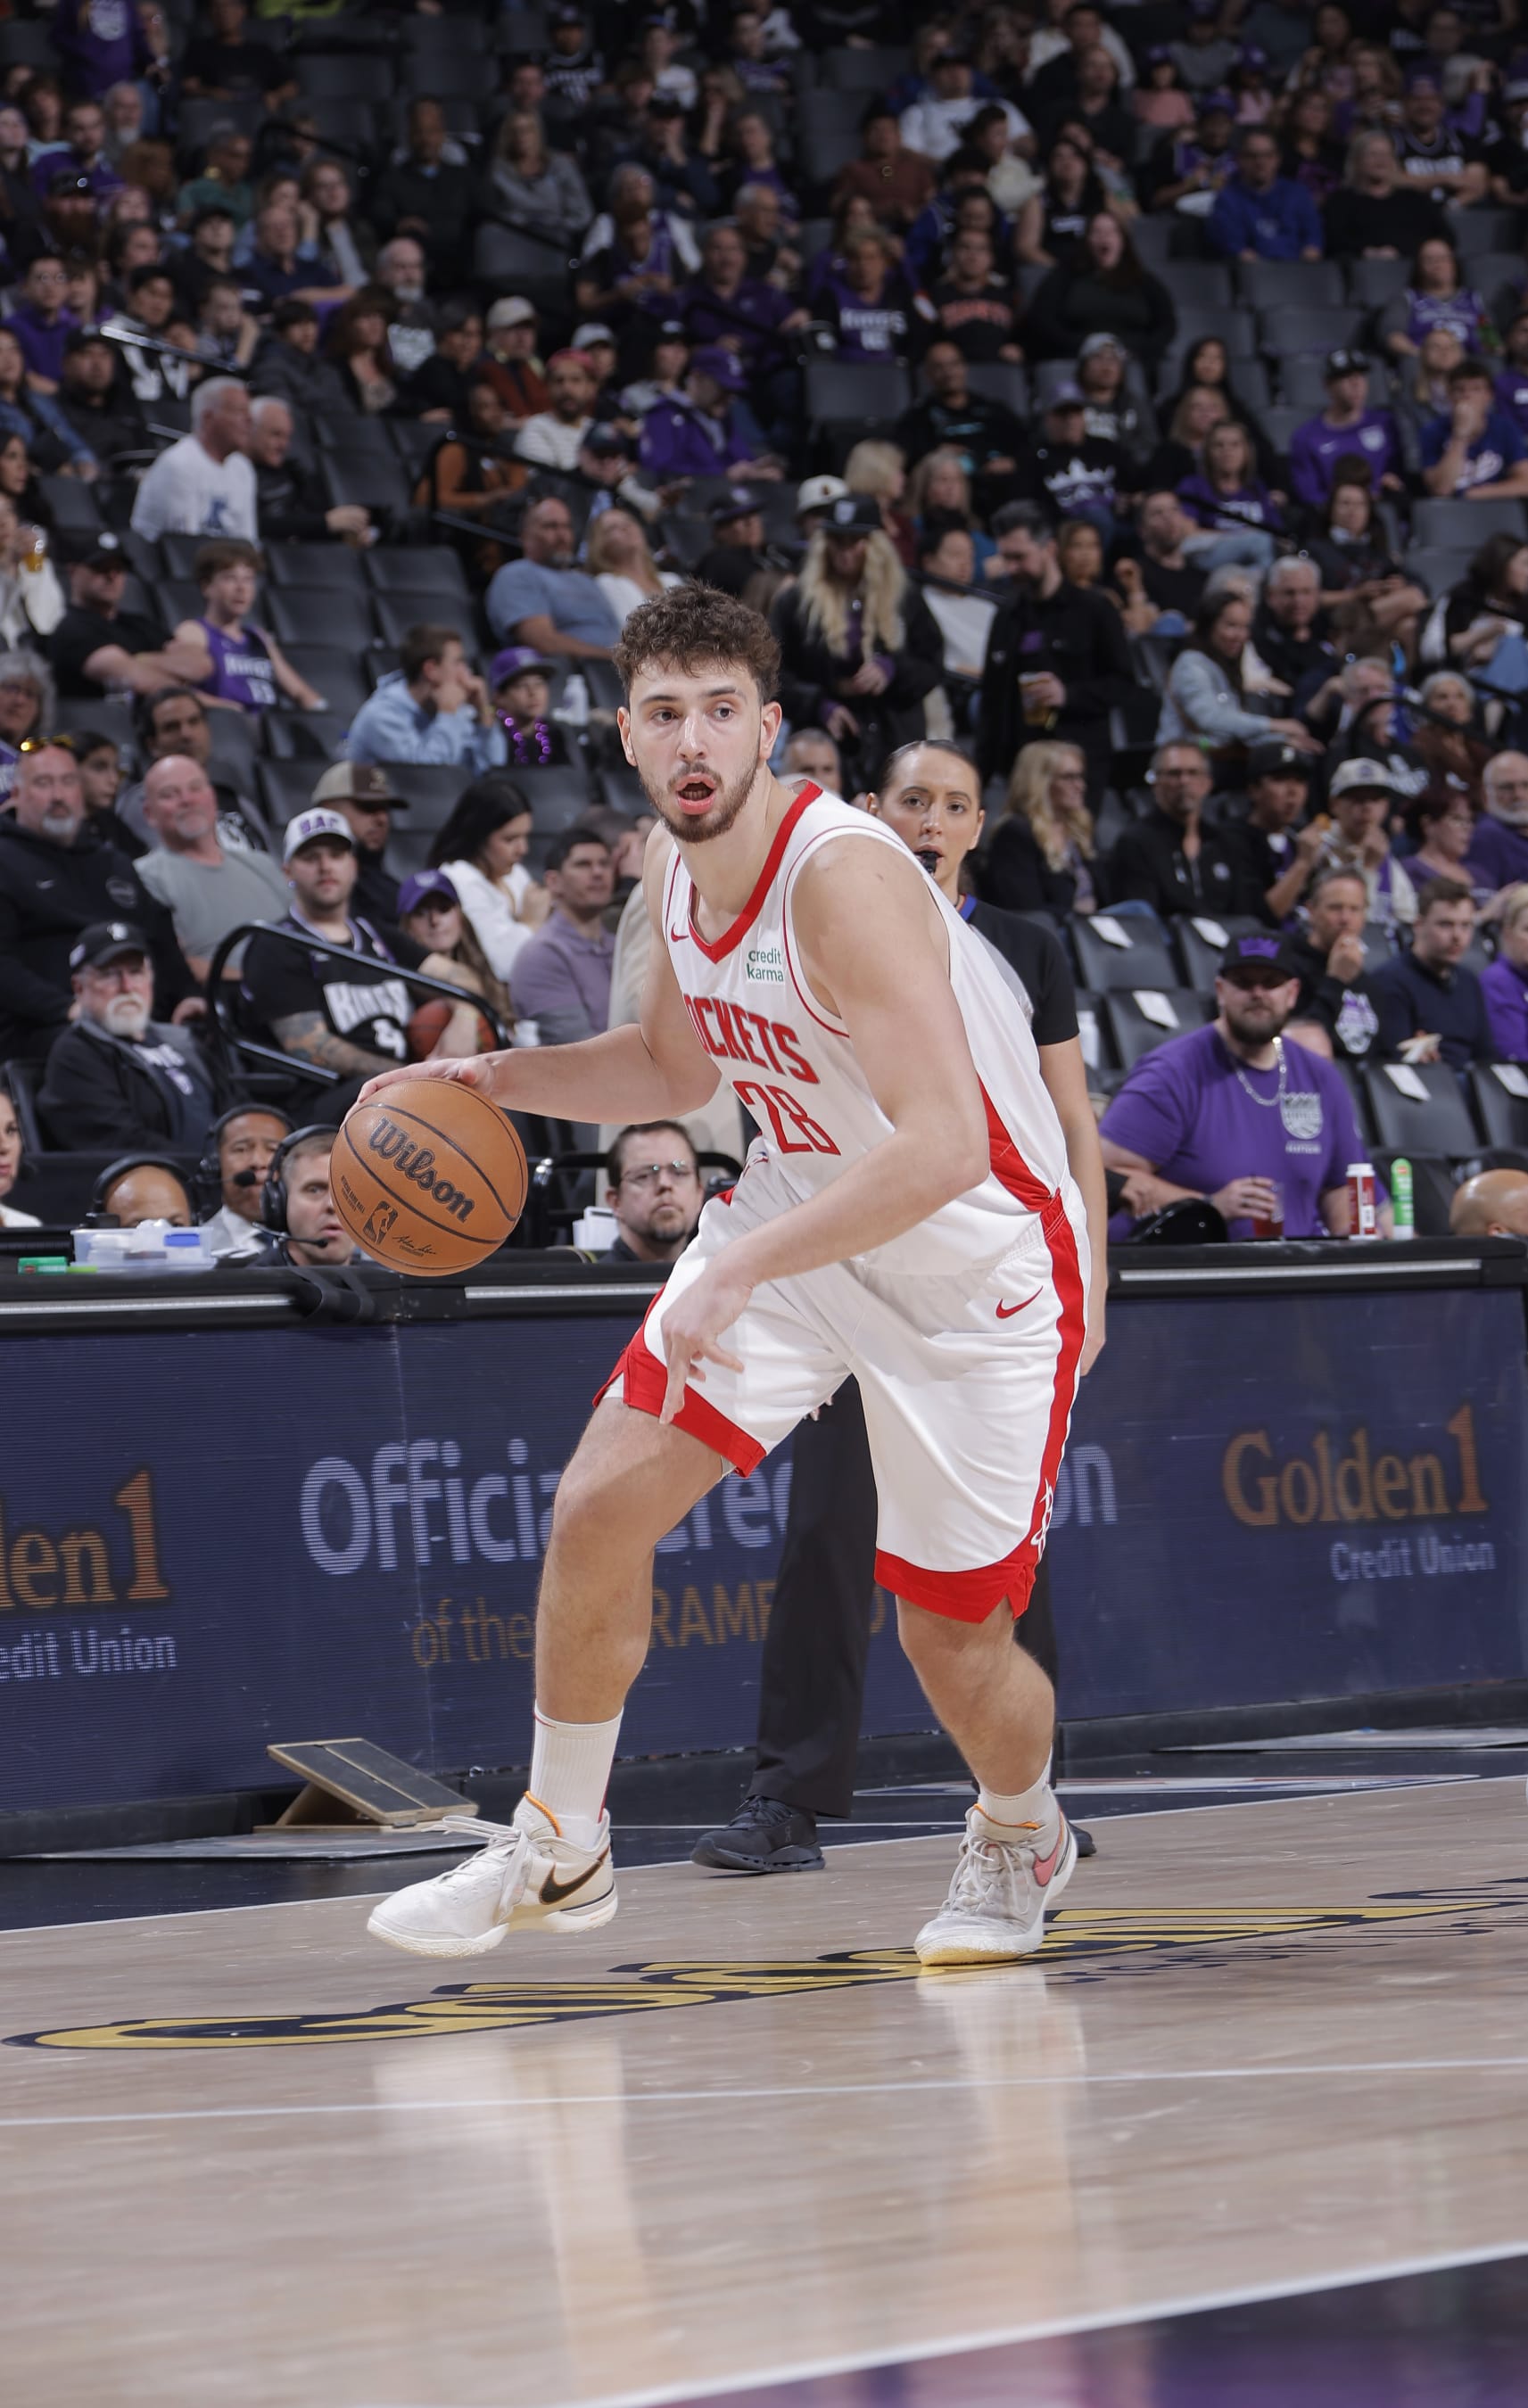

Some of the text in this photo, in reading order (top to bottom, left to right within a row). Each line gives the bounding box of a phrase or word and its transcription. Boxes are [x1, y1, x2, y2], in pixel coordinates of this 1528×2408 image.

[746, 963, 785, 982] karma
[747, 947, 781, 966] credit
[323, 979, 414, 1034] KINGS
[371, 1018, 406, 1059] 4
[732, 1080, 842, 1156] 28
[368, 1116, 475, 1224] Wilson
[1330, 1535, 1497, 1581] Credit Union
[70, 1624, 178, 1677] Union
[411, 1596, 535, 1667] of the
